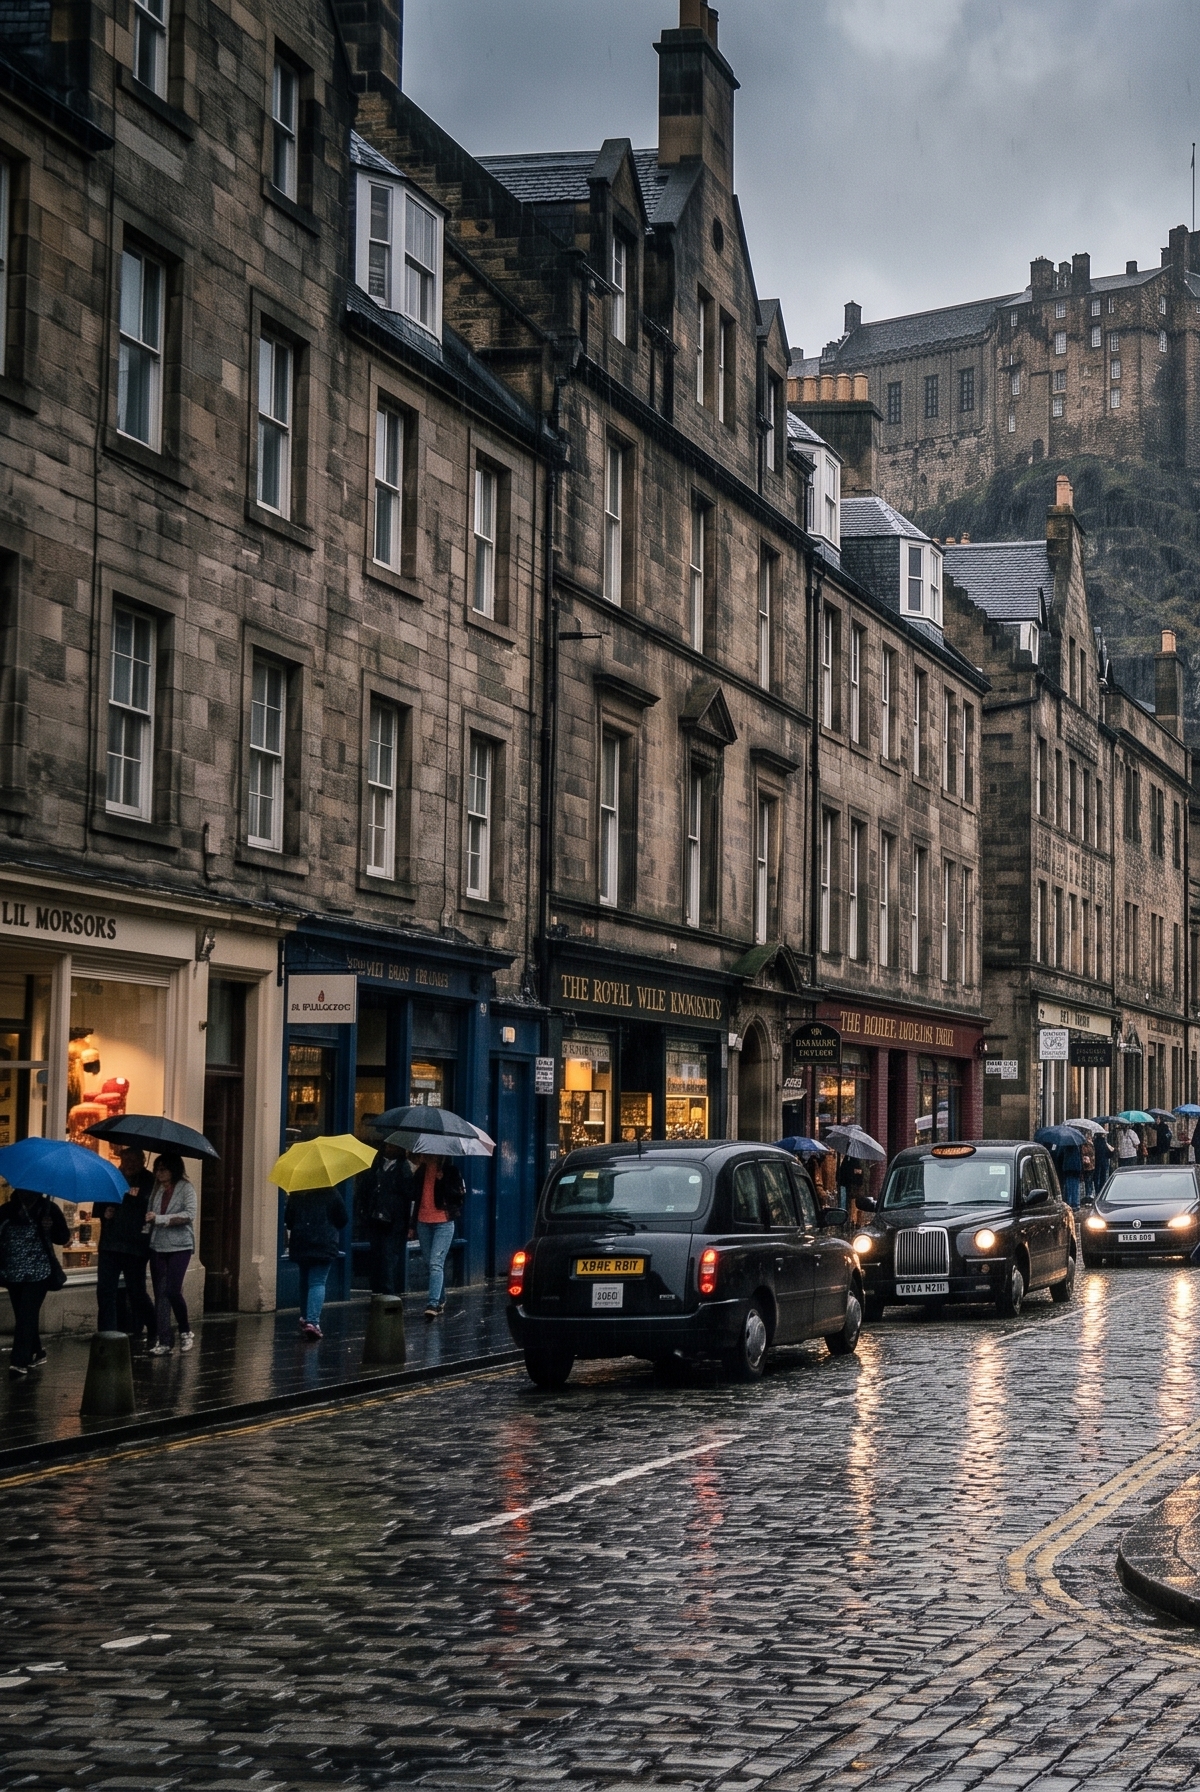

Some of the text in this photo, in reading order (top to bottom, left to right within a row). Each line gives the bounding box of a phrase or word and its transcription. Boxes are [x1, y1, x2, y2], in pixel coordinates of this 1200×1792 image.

[2, 901, 117, 940] LIL MORSORS
[561, 974, 589, 1001] THE
[636, 985, 666, 1012] WILE
[840, 1010, 861, 1033] THE
